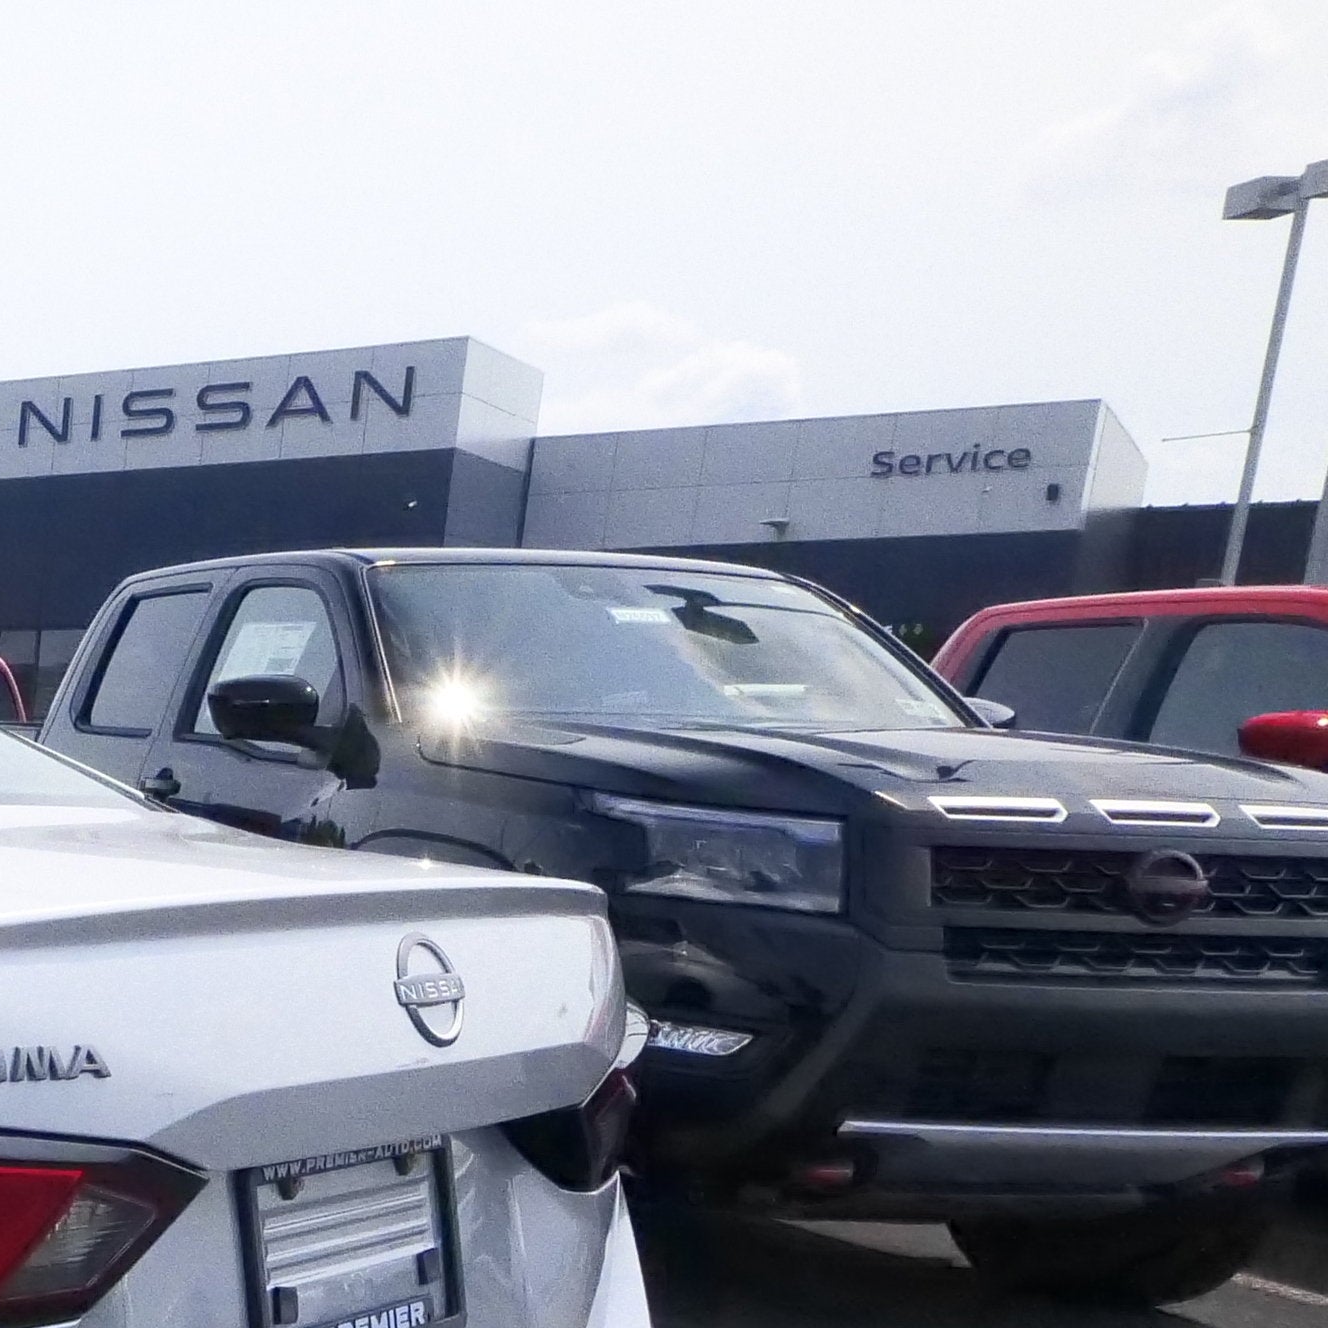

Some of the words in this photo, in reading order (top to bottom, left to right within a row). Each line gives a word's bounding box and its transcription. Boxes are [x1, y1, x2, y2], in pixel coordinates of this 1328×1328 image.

[17, 365, 417, 447] NISSAN
[870, 443, 1032, 479] Service
[399, 980, 462, 1001] NISSA
